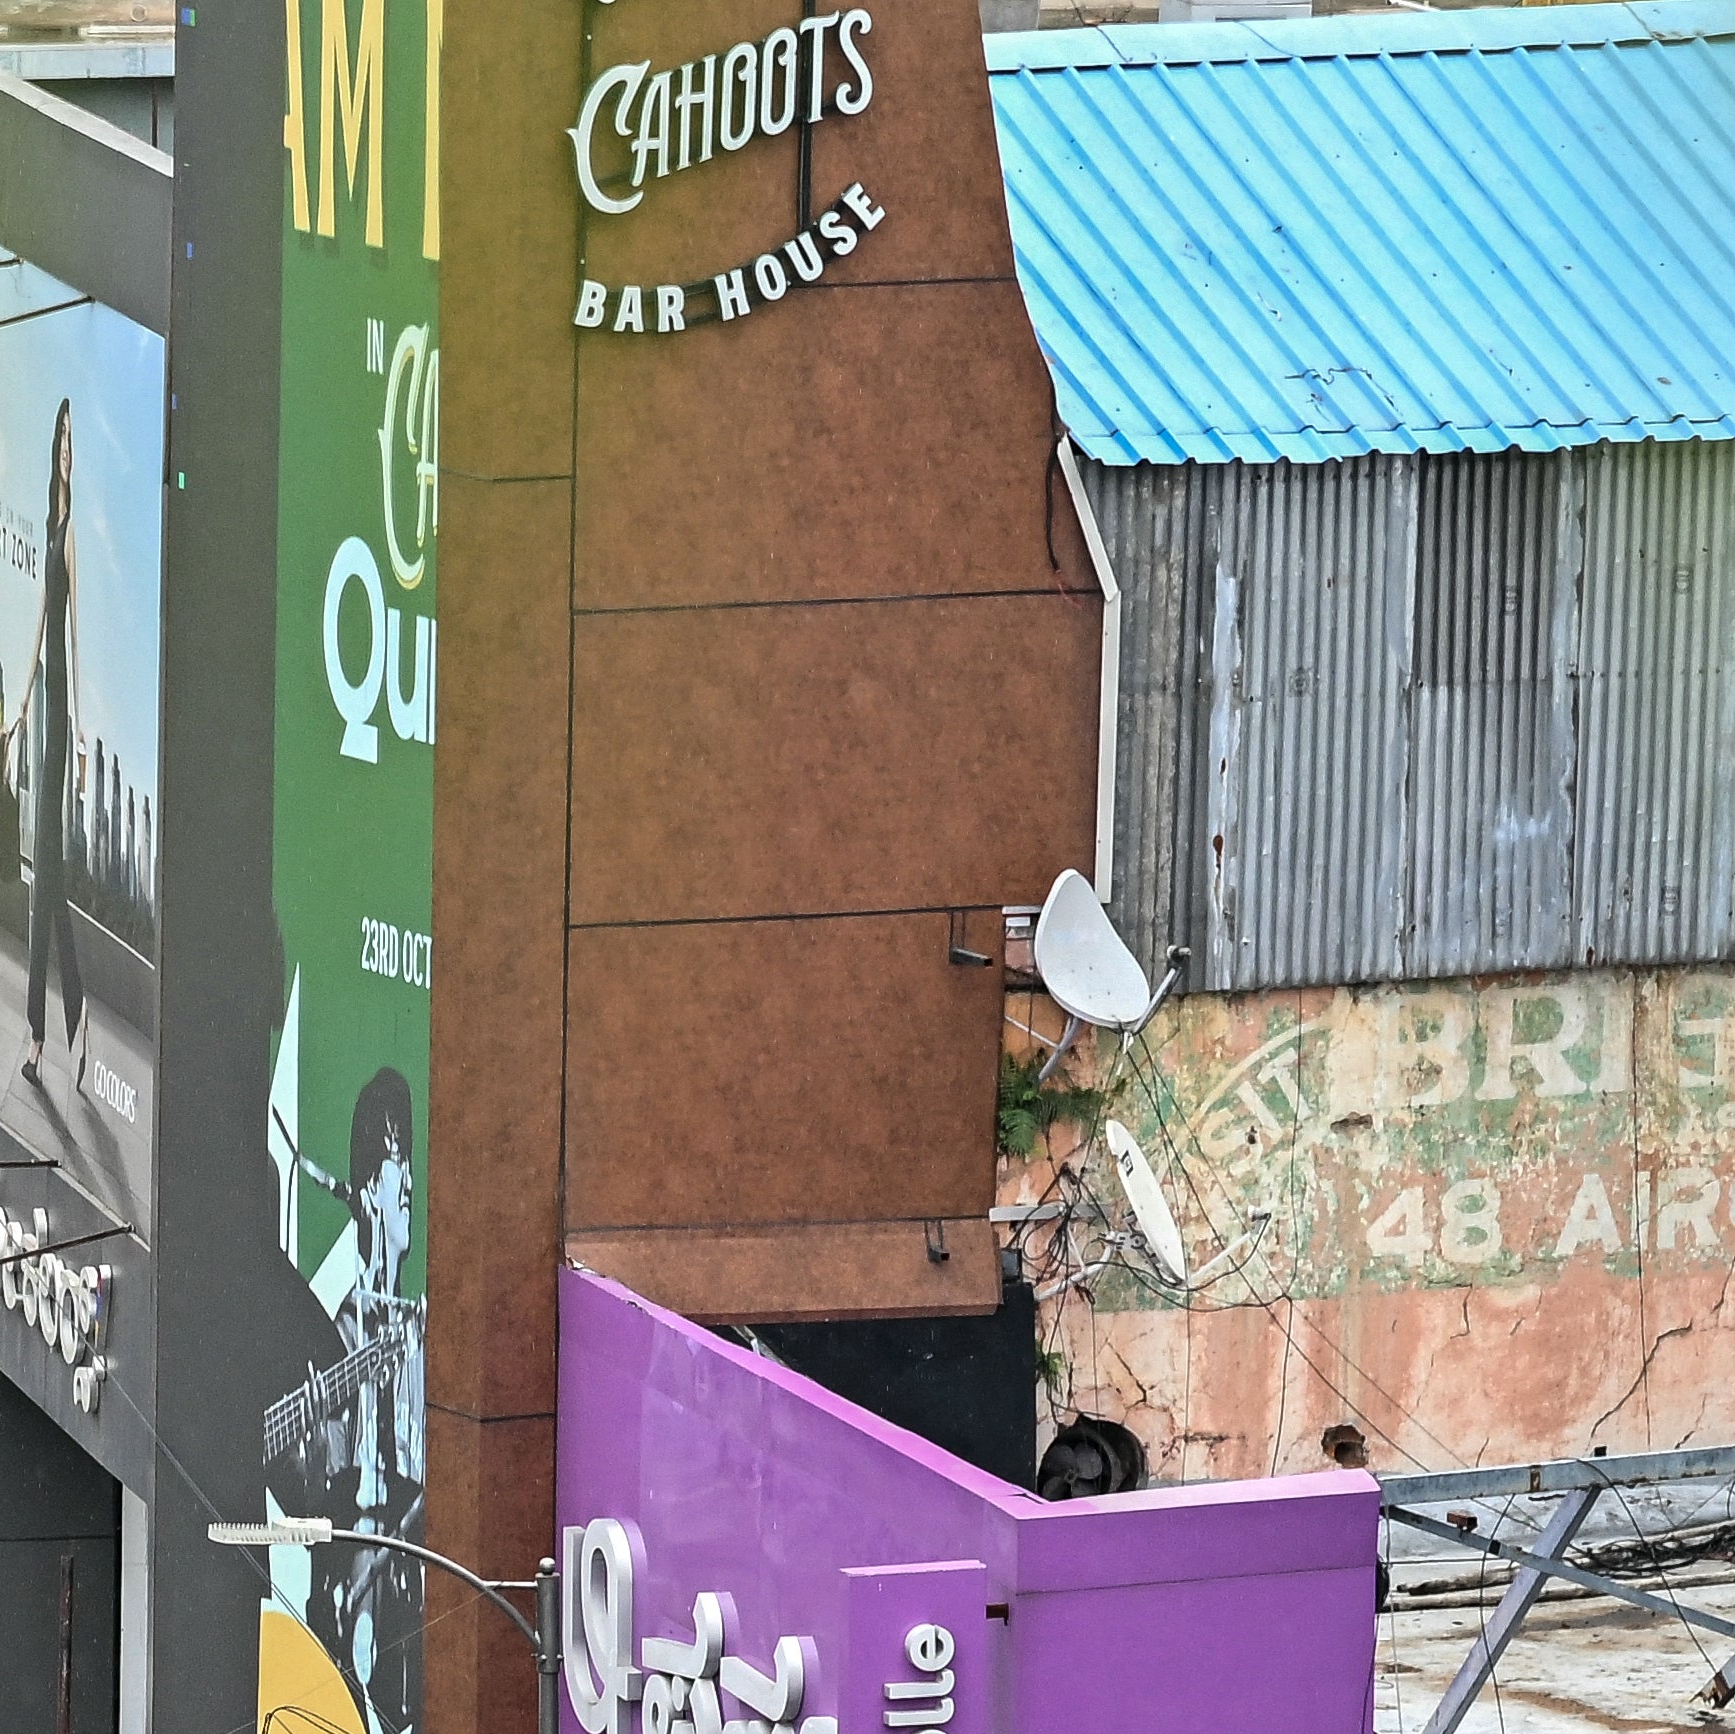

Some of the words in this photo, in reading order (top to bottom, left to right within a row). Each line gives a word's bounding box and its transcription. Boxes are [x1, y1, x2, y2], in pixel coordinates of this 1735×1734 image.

[565, 9, 874, 214] CAHOOTS
[574, 279, 687, 333] BAR
[714, 181, 886, 322] HOUSE
[366, 317, 384, 375] IN
[11, 533, 37, 580] ZONE
[323, 536, 436, 764] Qu
[360, 915, 399, 979] 23RD
[402, 929, 432, 990] OCT
[94, 1060, 107, 1099] GO
[1365, 1178, 1502, 1268] 48
